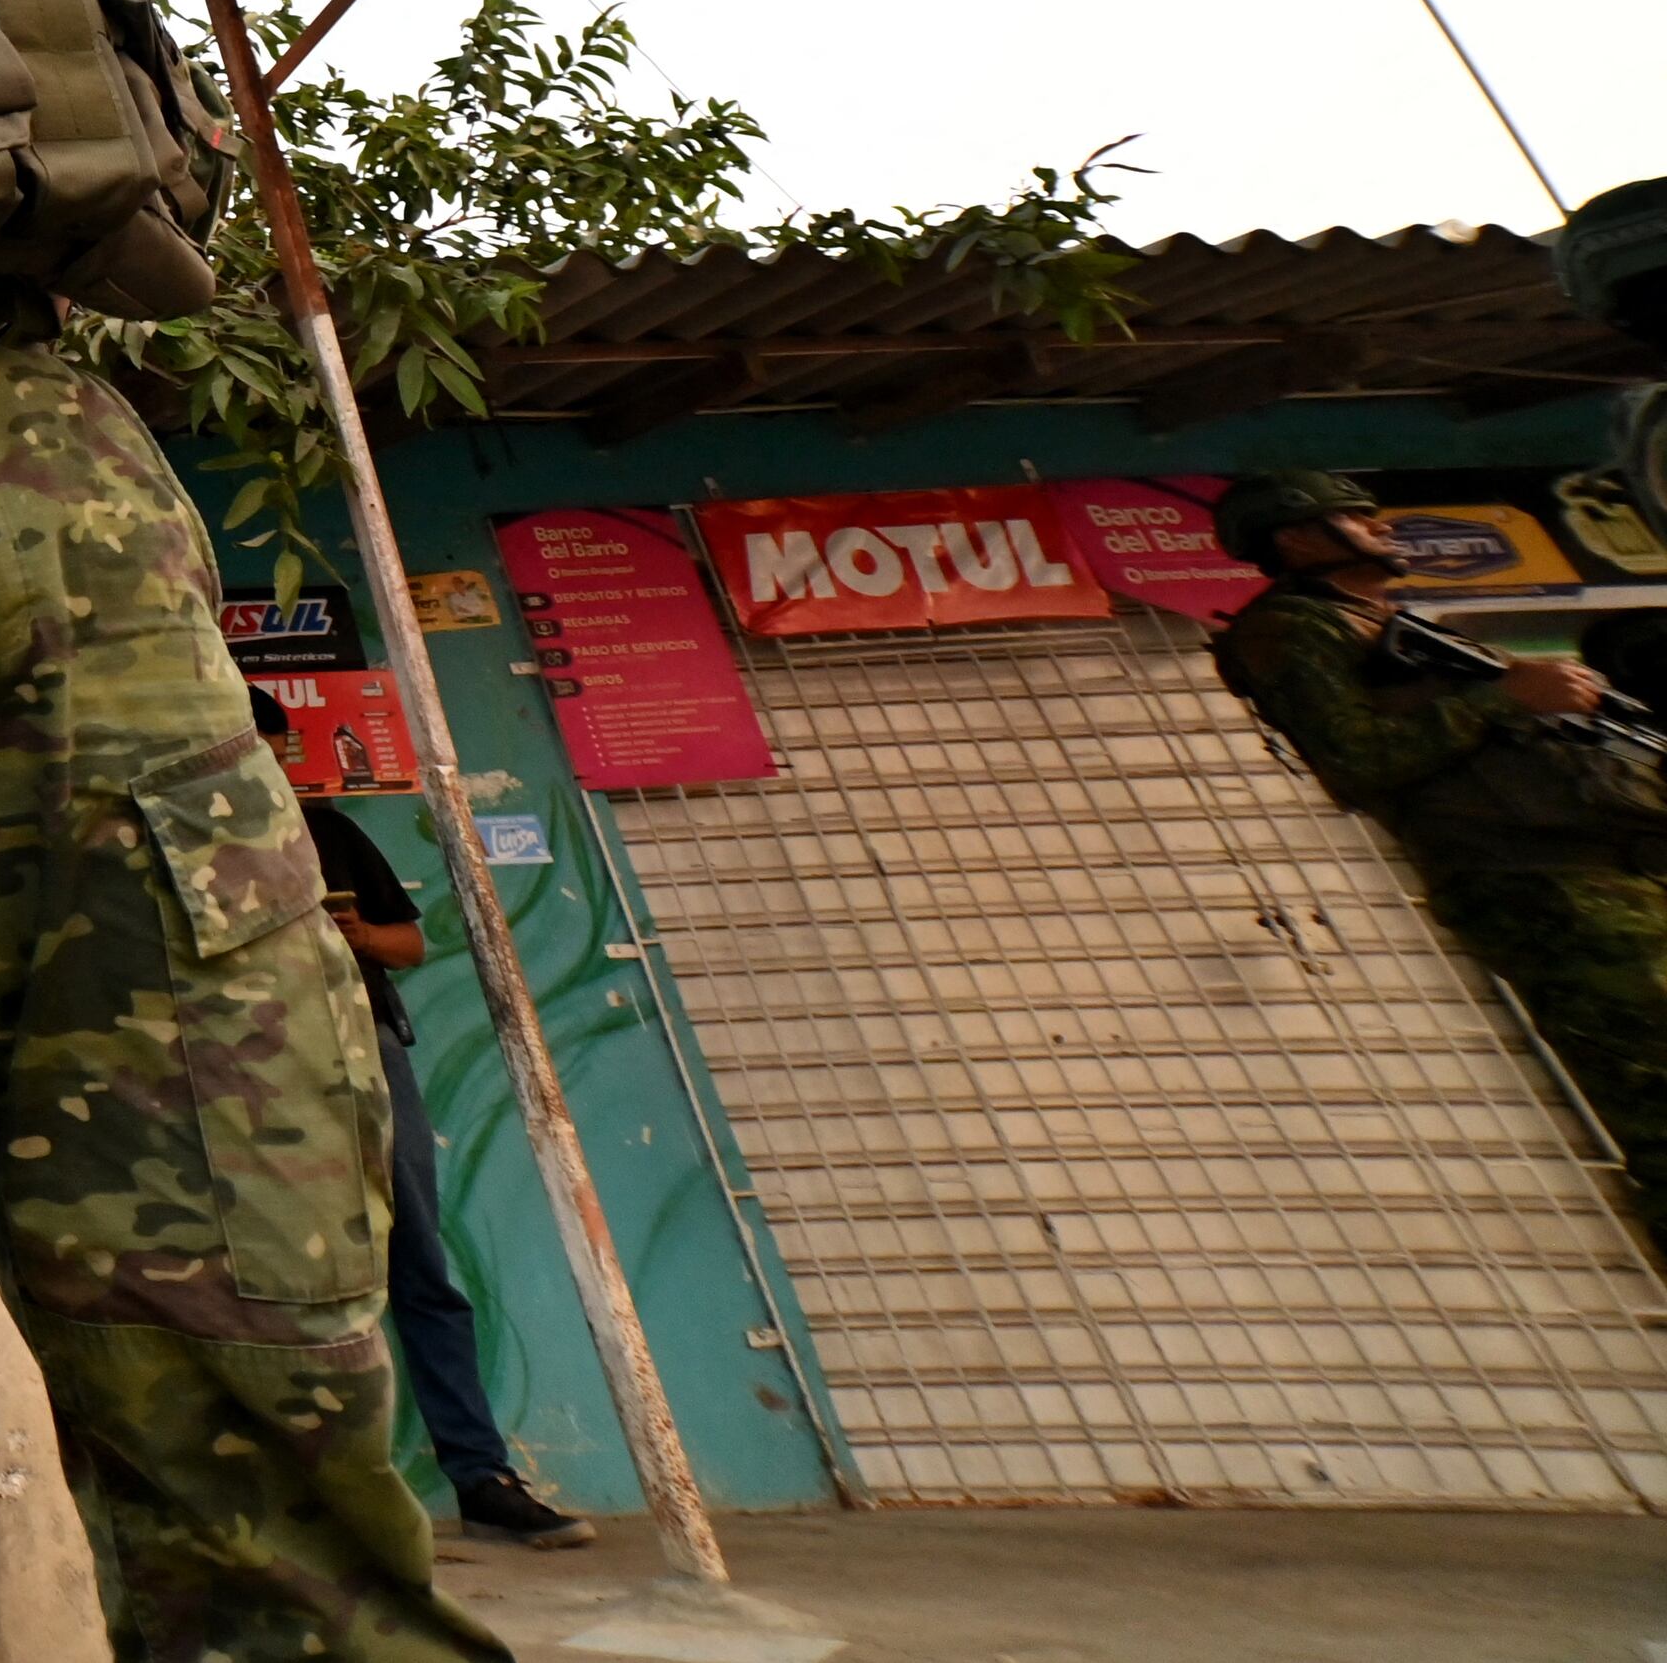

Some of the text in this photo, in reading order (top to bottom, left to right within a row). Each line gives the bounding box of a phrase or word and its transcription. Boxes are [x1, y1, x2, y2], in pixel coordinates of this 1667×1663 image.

[1085, 504, 1182, 527] Banco
[533, 526, 594, 542] Banco
[1103, 529, 1217, 553] del Barr
[540, 539, 629, 560] del Barrio
[1392, 536, 1507, 557] sunami
[745, 519, 1073, 603] MOTUL
[625, 588, 634, 599] Y
[636, 585, 689, 599] RETIROS
[220, 601, 332, 636] SOIL
[562, 613, 631, 628] RECARGAS
[571, 639, 699, 657] PAGO DE SERVICIOS
[582, 672, 624, 687] GIROS
[252, 678, 327, 709] TUL
